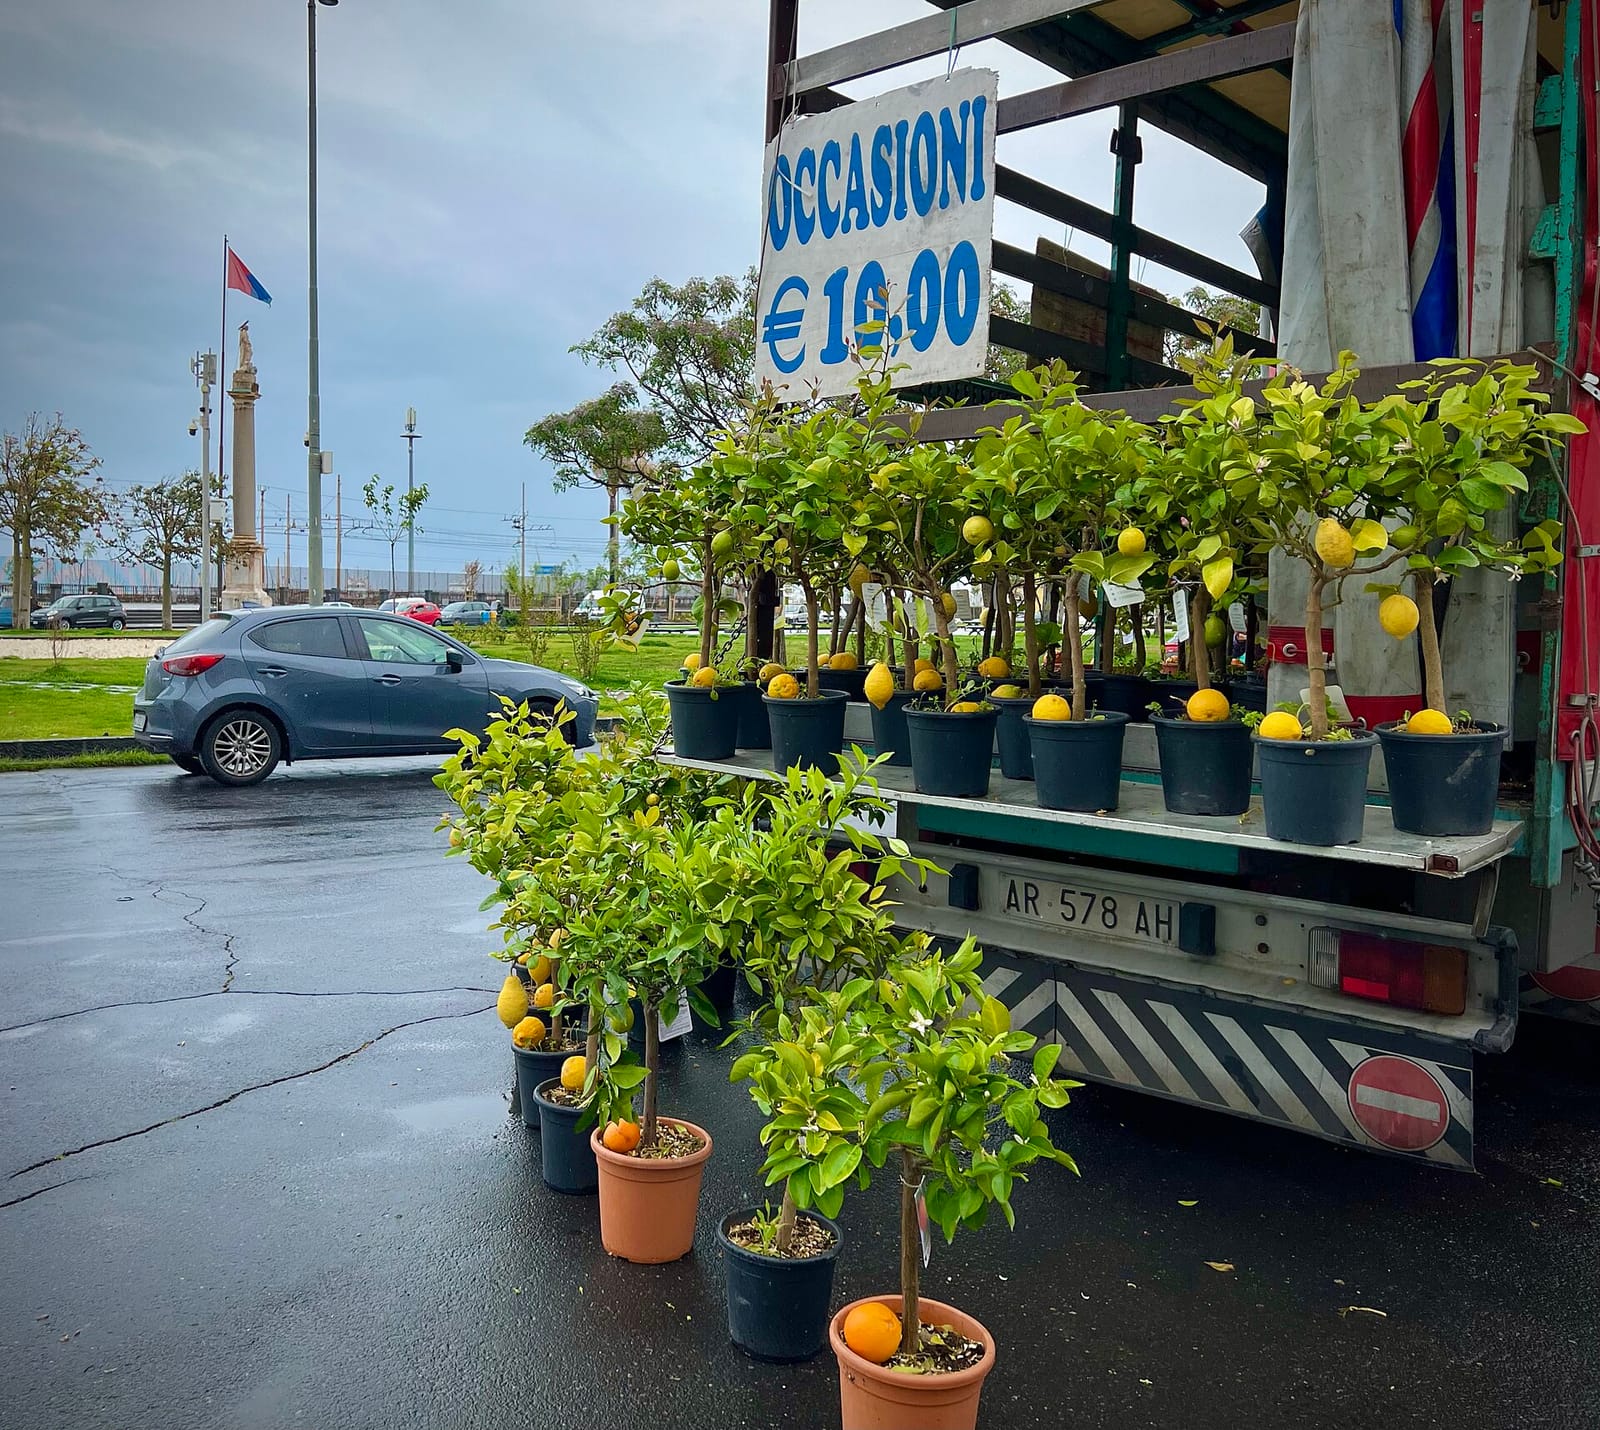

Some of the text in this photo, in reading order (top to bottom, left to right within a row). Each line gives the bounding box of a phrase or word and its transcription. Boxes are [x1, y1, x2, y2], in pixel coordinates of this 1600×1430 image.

[769, 95, 987, 251] OCCASIONI
[762, 276, 810, 374] €
[1006, 879, 1173, 941] AR 578 AH
